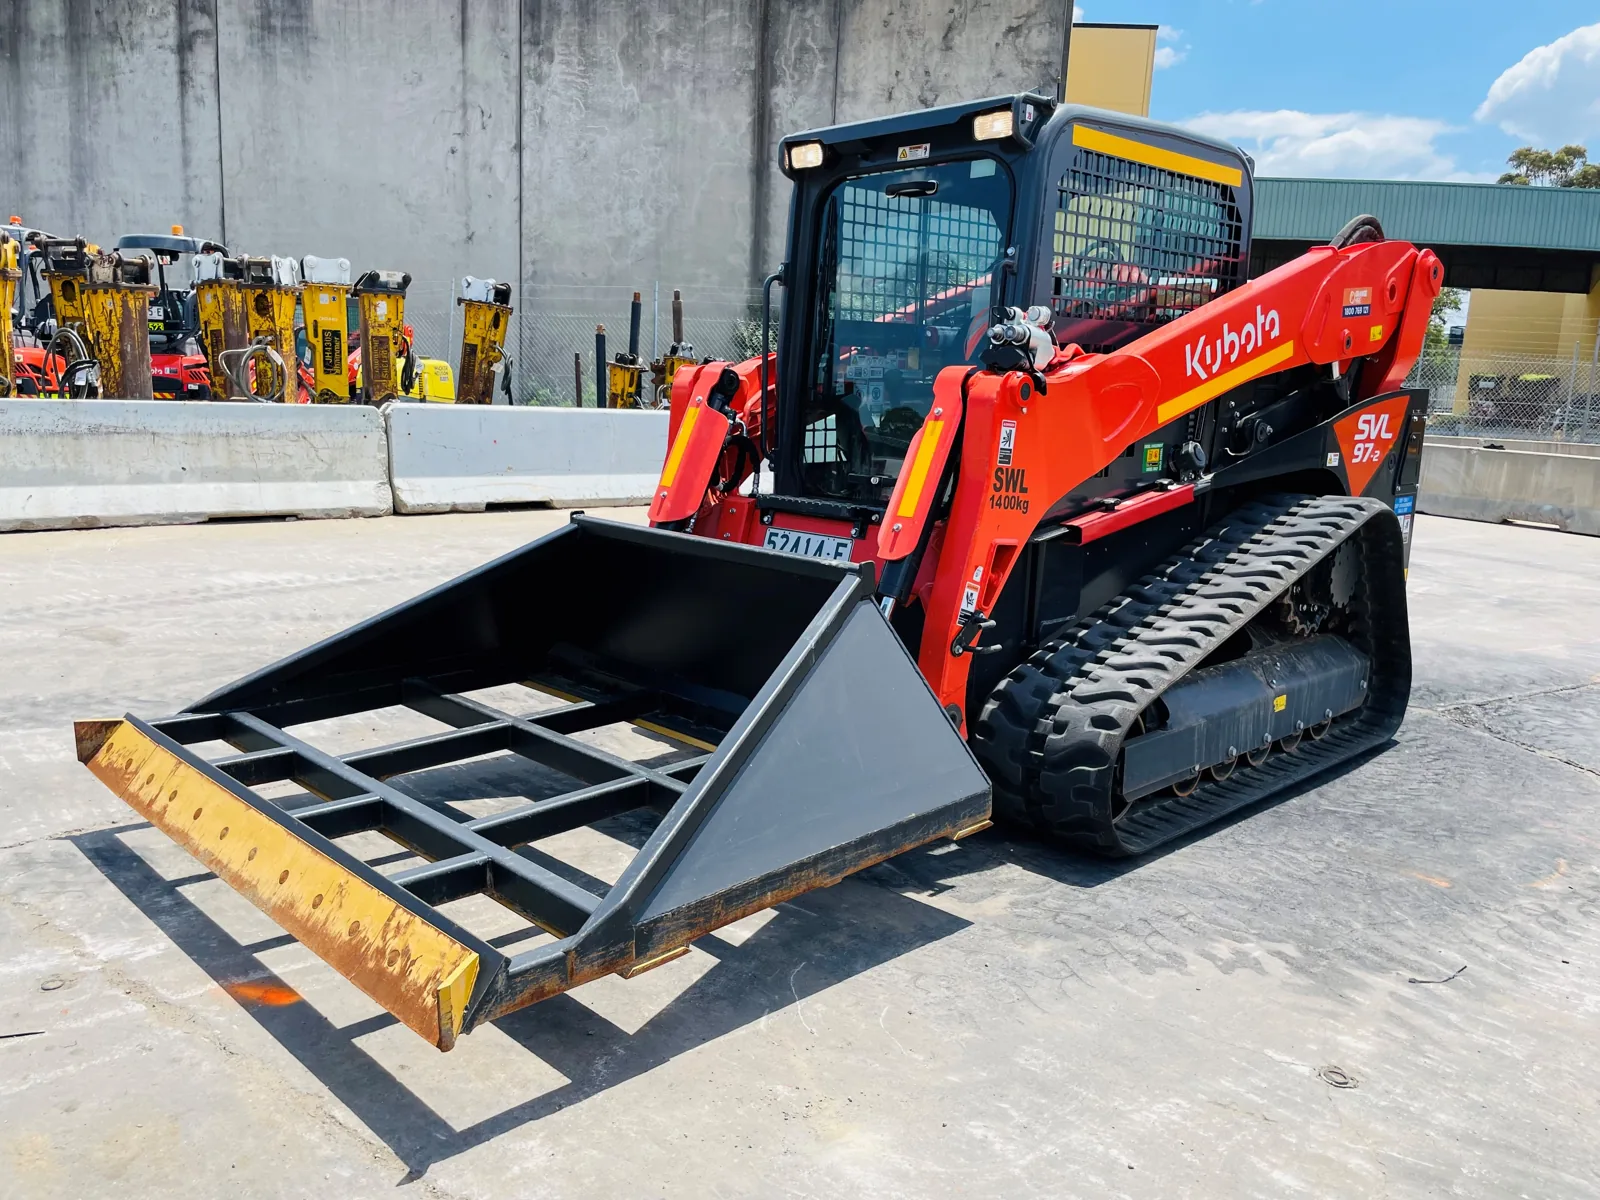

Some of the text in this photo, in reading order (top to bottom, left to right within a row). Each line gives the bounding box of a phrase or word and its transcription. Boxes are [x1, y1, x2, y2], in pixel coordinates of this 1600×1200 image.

[1185, 304, 1280, 380] Kubota
[1354, 414, 1393, 441] SVL
[992, 467, 1029, 494] SWL
[989, 494, 1029, 515] 1400kg
